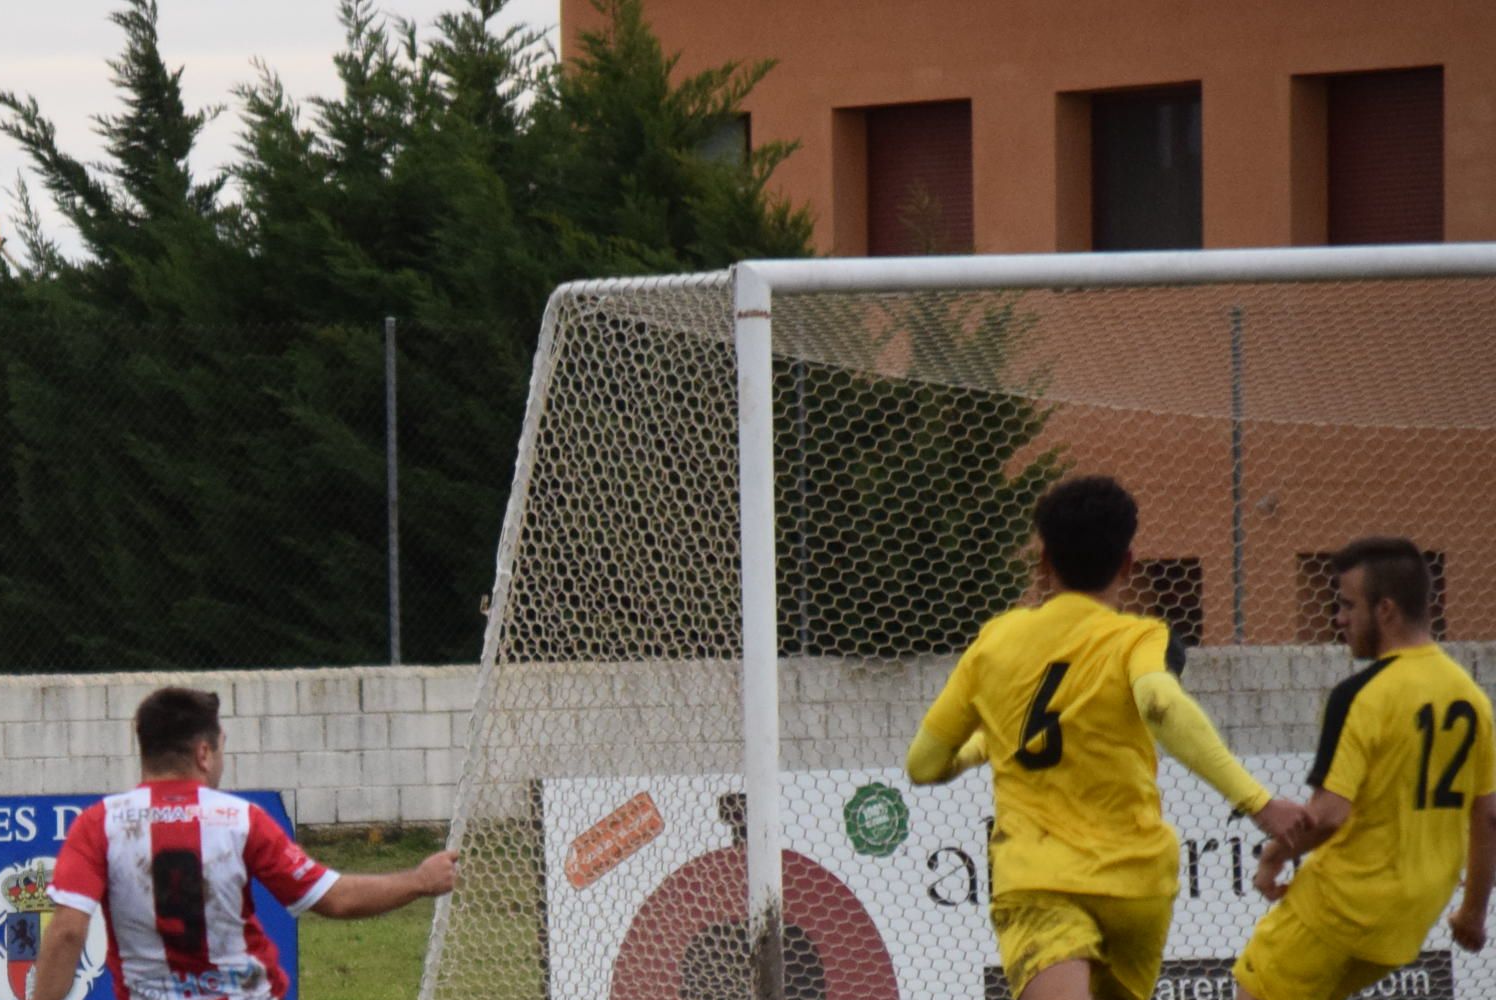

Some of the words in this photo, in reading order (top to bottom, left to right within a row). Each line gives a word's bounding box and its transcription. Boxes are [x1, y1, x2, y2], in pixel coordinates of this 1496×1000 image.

[1014, 661, 1070, 771] 6
[1414, 700, 1476, 809] 12
[151, 849, 204, 956] 9
